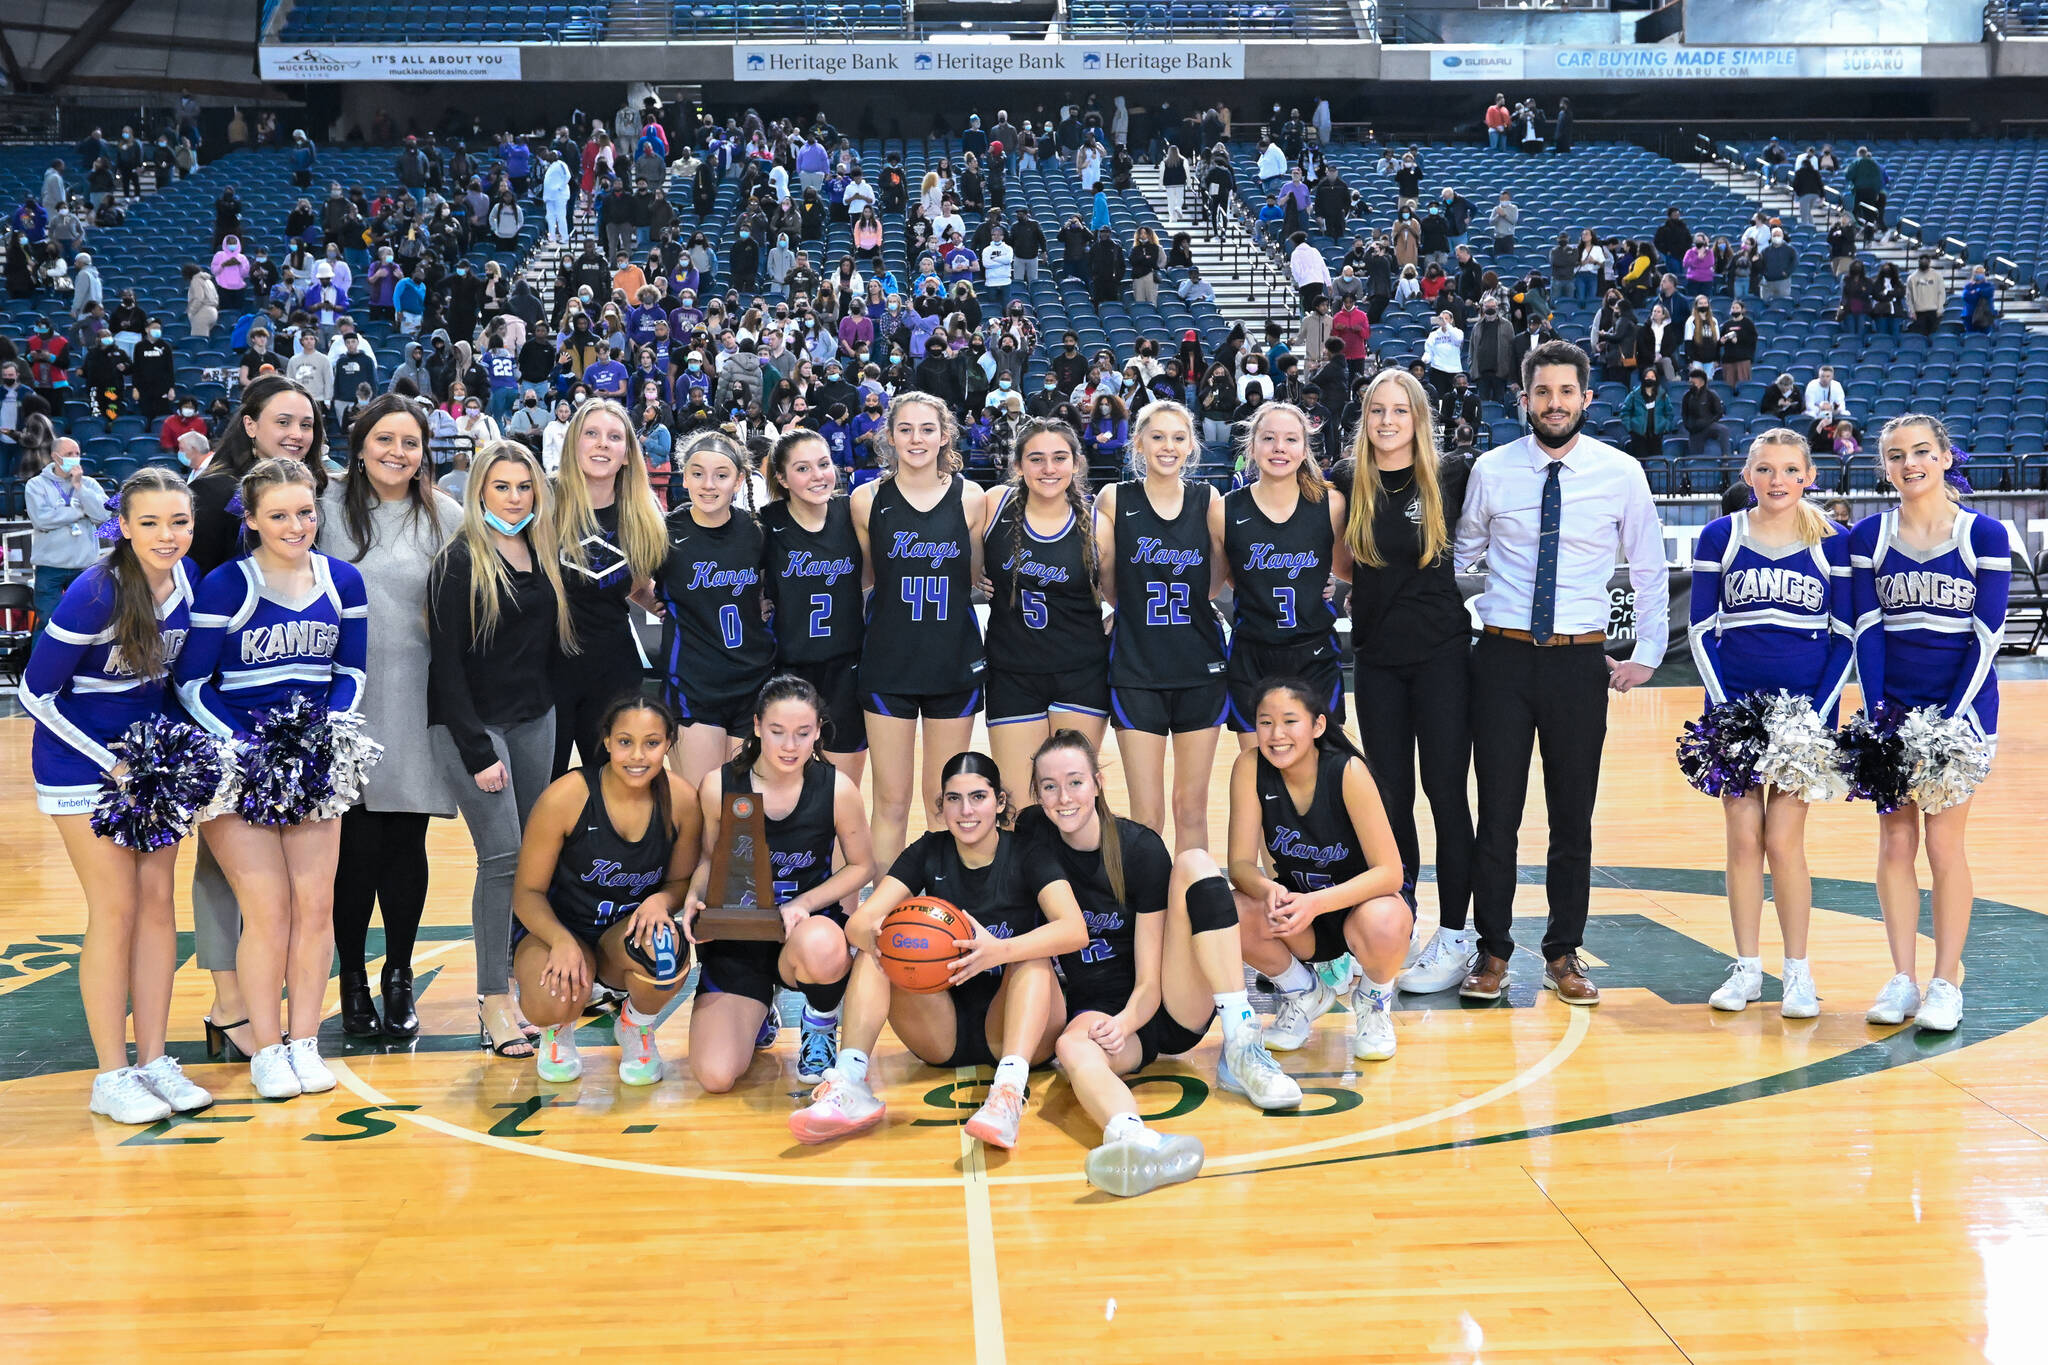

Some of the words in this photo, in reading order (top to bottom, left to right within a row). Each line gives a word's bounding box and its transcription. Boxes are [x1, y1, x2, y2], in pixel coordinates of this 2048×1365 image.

[372, 55, 396, 64] IT'S
[400, 55, 424, 64] ALL
[429, 55, 472, 64] ABOUT
[477, 55, 503, 64] YOU
[389, 67, 487, 76] muckleshootcasino.com
[770, 53, 847, 75] Heritage
[852, 53, 899, 70] Bank
[937, 53, 1014, 74] Heritage
[1019, 53, 1065, 69] Bank
[1106, 53, 1181, 74] Heritage
[1186, 53, 1232, 69] Bank
[1465, 58, 1512, 66] SUBARU
[1557, 52, 1592, 68] CAR
[1598, 52, 1668, 67] BUYING
[1674, 51, 1726, 65] MADE
[1731, 51, 1797, 65] SIMPLE
[1843, 58, 1904, 71] SUBARU
[492, 358, 513, 377] 22
[782, 550, 854, 586] Kangs
[887, 531, 960, 569] Kangs
[1002, 548, 1069, 586] Kangs
[1130, 536, 1203, 576] Kangs
[1244, 542, 1320, 579] Kangs
[686, 561, 758, 597] Kangs
[1725, 568, 1824, 612] KANGS
[1875, 571, 1976, 613] KANGS
[809, 593, 832, 638] 2
[901, 576, 949, 621] 44
[1020, 589, 1049, 630] 5
[1146, 582, 1191, 626] 22
[1272, 587, 1297, 629] 3
[241, 621, 341, 664] KANGS
[719, 604, 743, 649] 0
[58, 797, 90, 807] Kimberly
[1268, 825, 1349, 868] Kangs
[892, 932, 929, 950] Gesa
